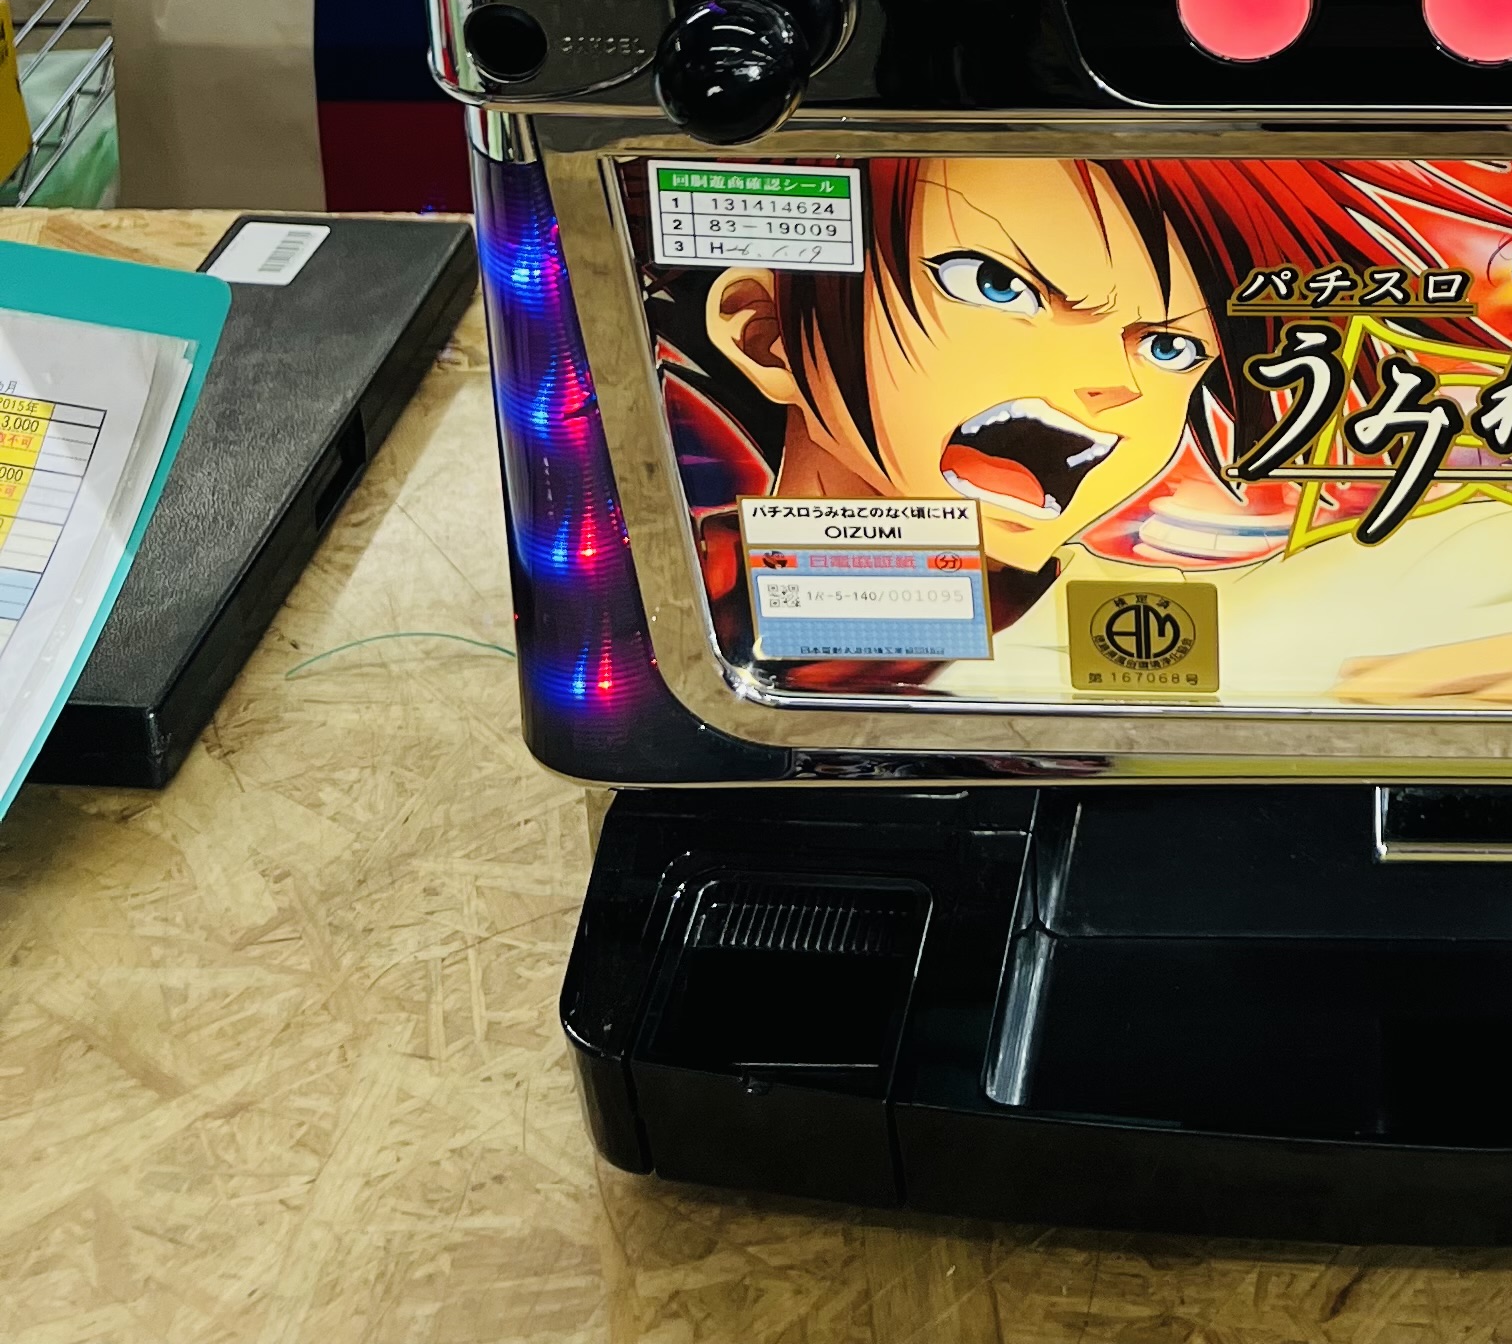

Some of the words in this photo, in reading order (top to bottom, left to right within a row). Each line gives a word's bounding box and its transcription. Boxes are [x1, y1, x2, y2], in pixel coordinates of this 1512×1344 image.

[672, 174, 835, 193] 回胴遊商確認シール
[672, 197, 680, 208] 1
[711, 198, 834, 215] 131414624
[673, 219, 683, 230] 2
[674, 240, 684, 252] 3
[1236, 266, 1471, 306] パチスロ
[752, 505, 969, 520] パチスロうみねこのなく頃にHX
[824, 526, 902, 539] OIZUMI
